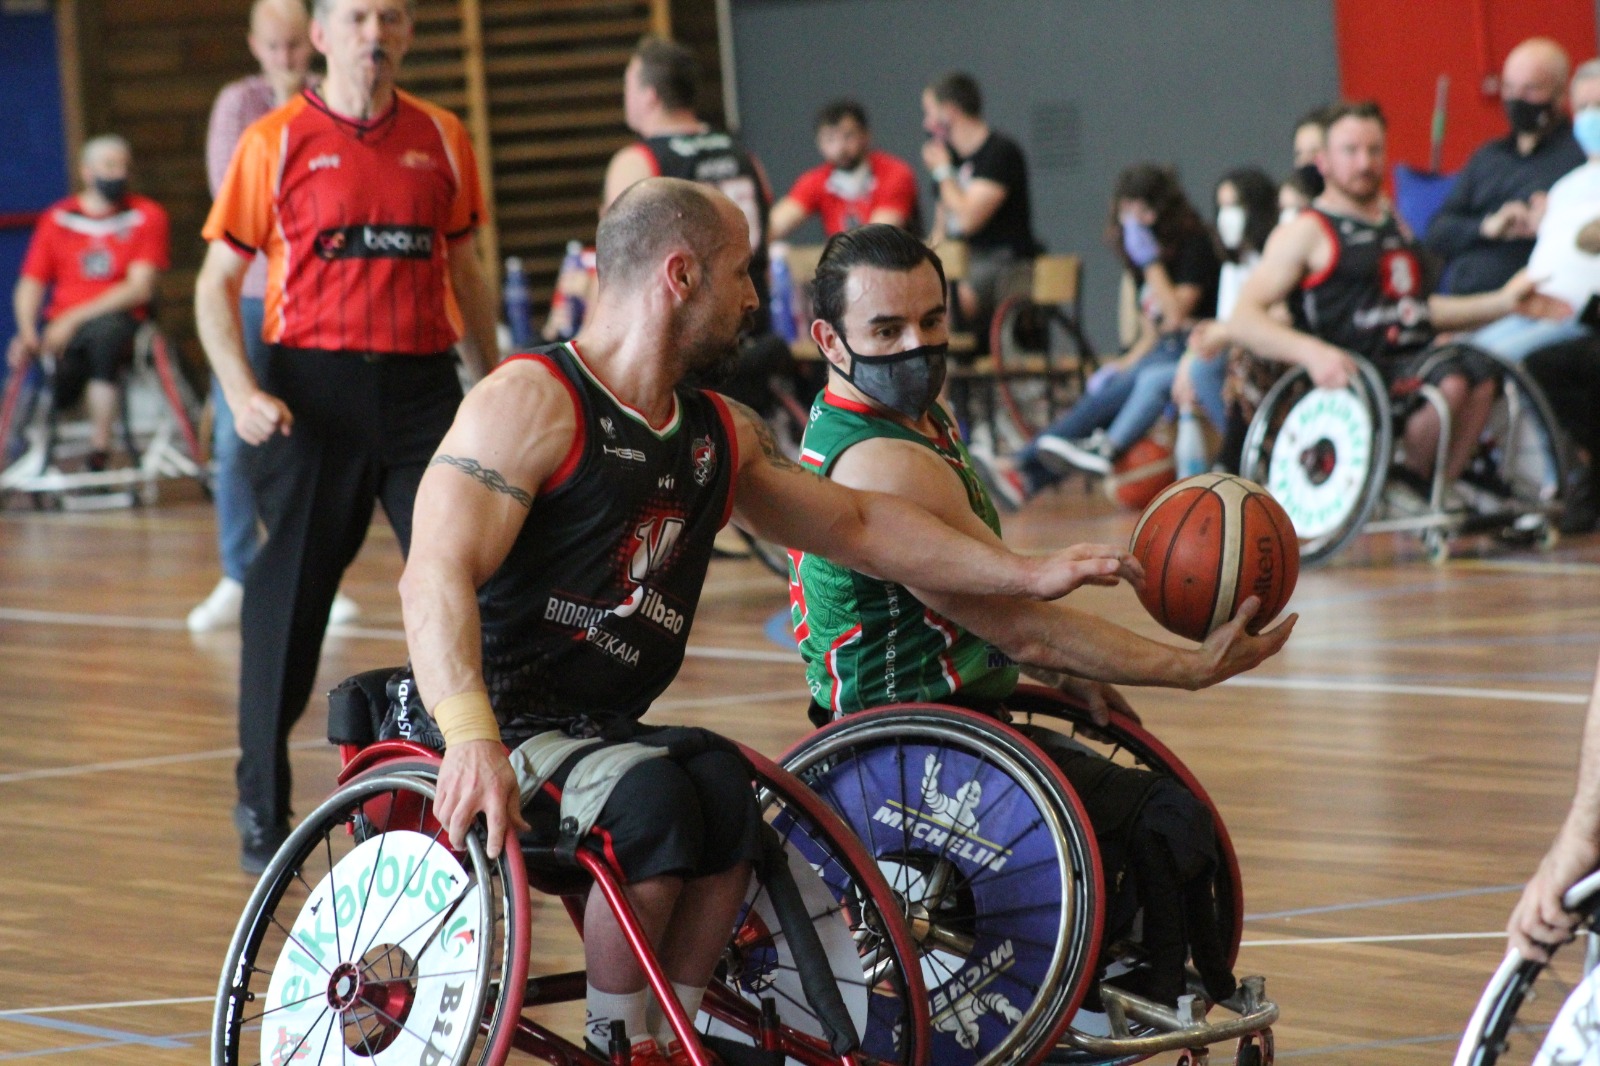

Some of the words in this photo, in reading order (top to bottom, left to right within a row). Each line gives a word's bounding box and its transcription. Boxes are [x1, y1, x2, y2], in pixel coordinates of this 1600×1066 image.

[586, 626, 640, 667] BIZKAIA
[884, 628, 898, 703] BASQUECOUN
[872, 805, 1008, 872] MICHELIN
[281, 849, 452, 1012] elkarbus
